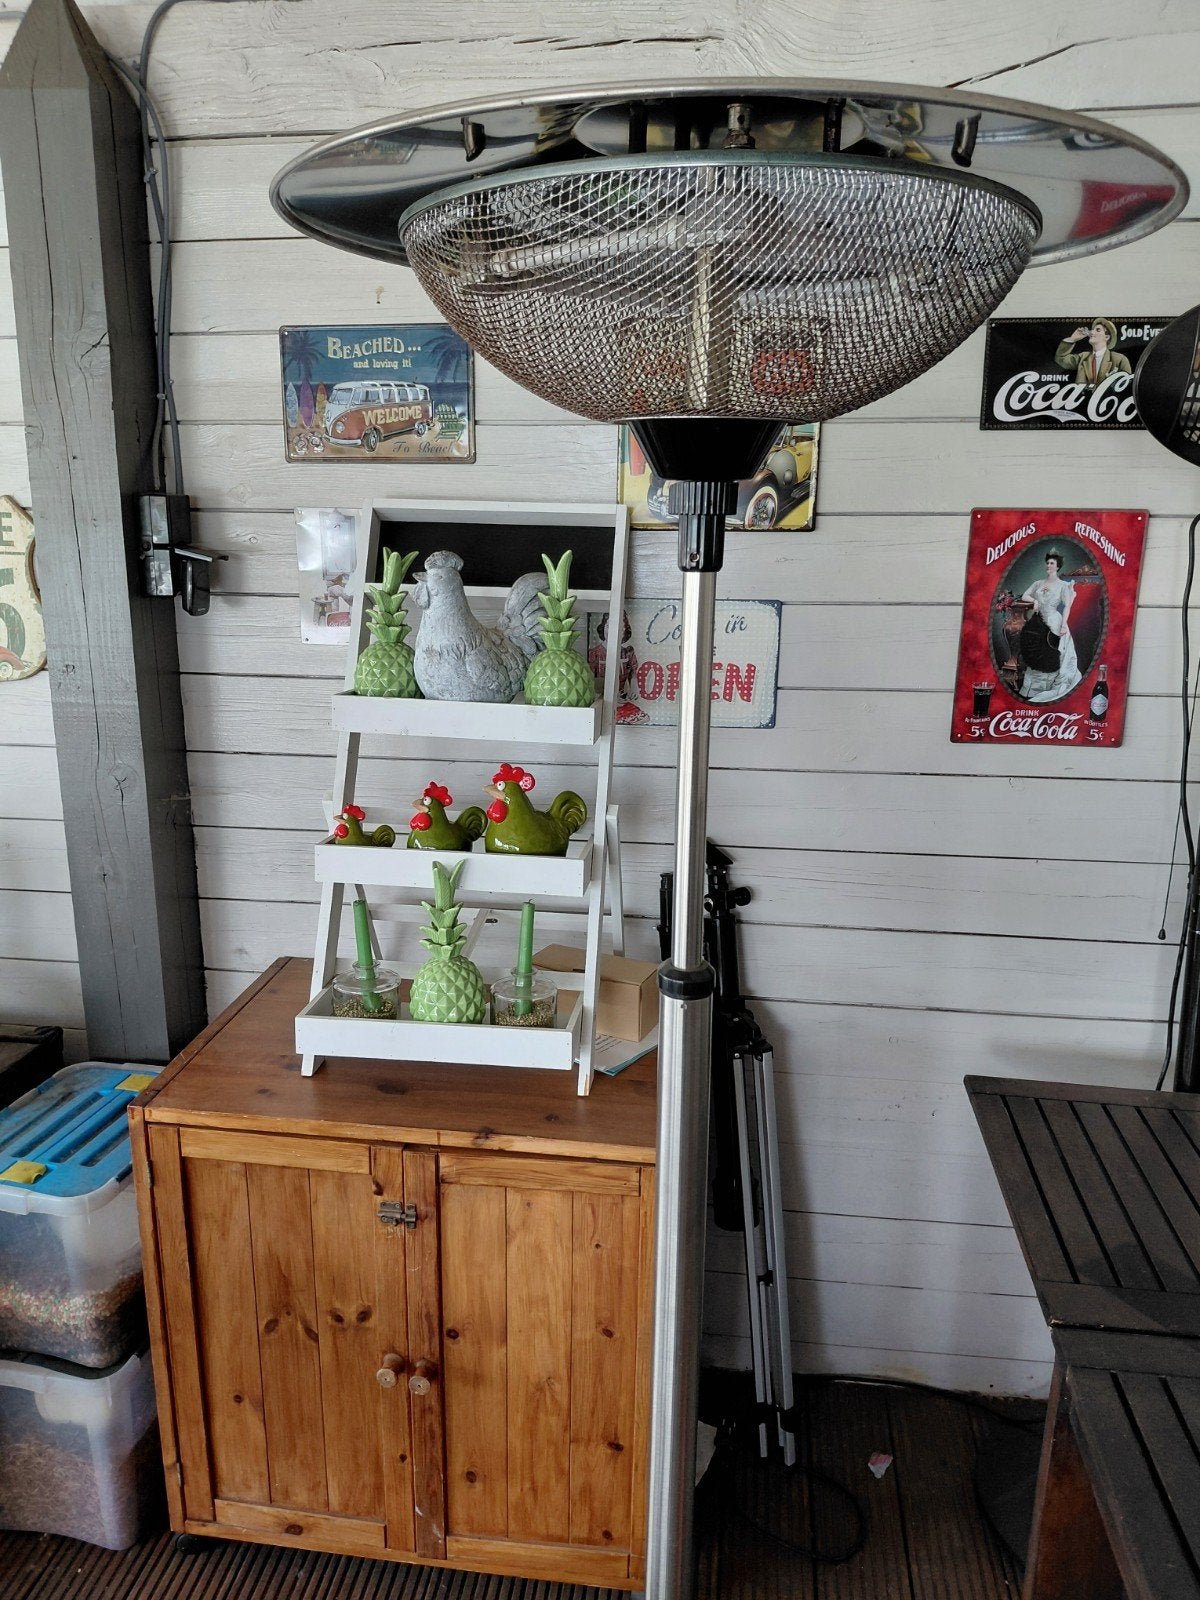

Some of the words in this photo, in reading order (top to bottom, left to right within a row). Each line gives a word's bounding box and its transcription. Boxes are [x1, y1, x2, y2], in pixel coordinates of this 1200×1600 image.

[1120, 325, 1143, 341] SOLD
[1143, 324, 1164, 341] EVE
[353, 359, 369, 368] and
[372, 359, 398, 370] loving
[1041, 374, 1070, 382] DRINK
[993, 371, 1137, 422] Coca-Co
[362, 405, 423, 427] WELCOME
[392, 441, 410, 453] To
[986, 522, 1036, 566] DELICIOUS
[1075, 522, 1126, 567] REFRESHING
[725, 614, 748, 634] in
[1015, 709, 1040, 717] DRINK
[989, 710, 1085, 740] Coca-Cola
